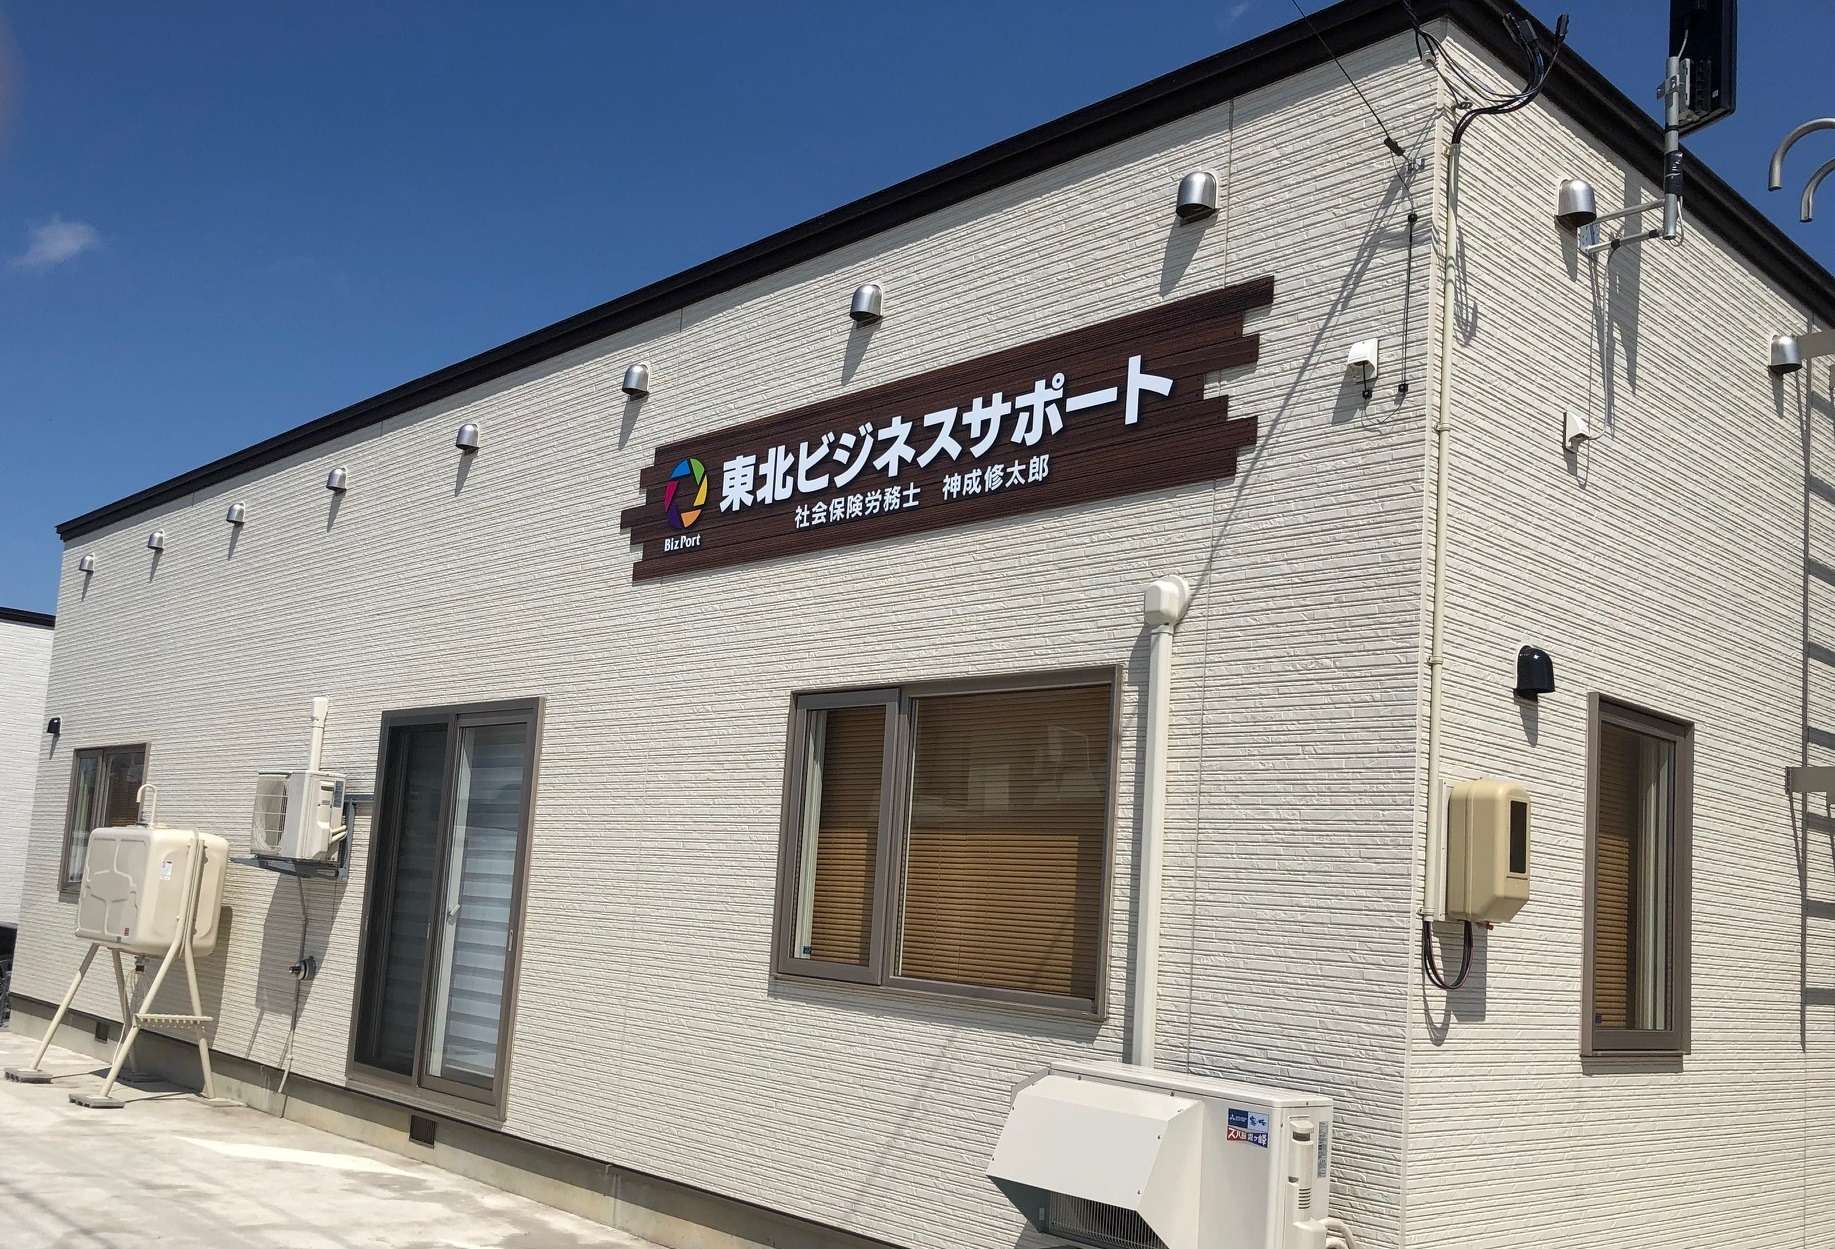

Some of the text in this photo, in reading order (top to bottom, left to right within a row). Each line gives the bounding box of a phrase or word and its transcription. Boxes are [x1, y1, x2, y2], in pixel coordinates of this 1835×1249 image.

[719, 355, 1174, 512] 東北ビジネスサポート
[794, 454, 1050, 529] 社会保険労務士 神成修太郎
